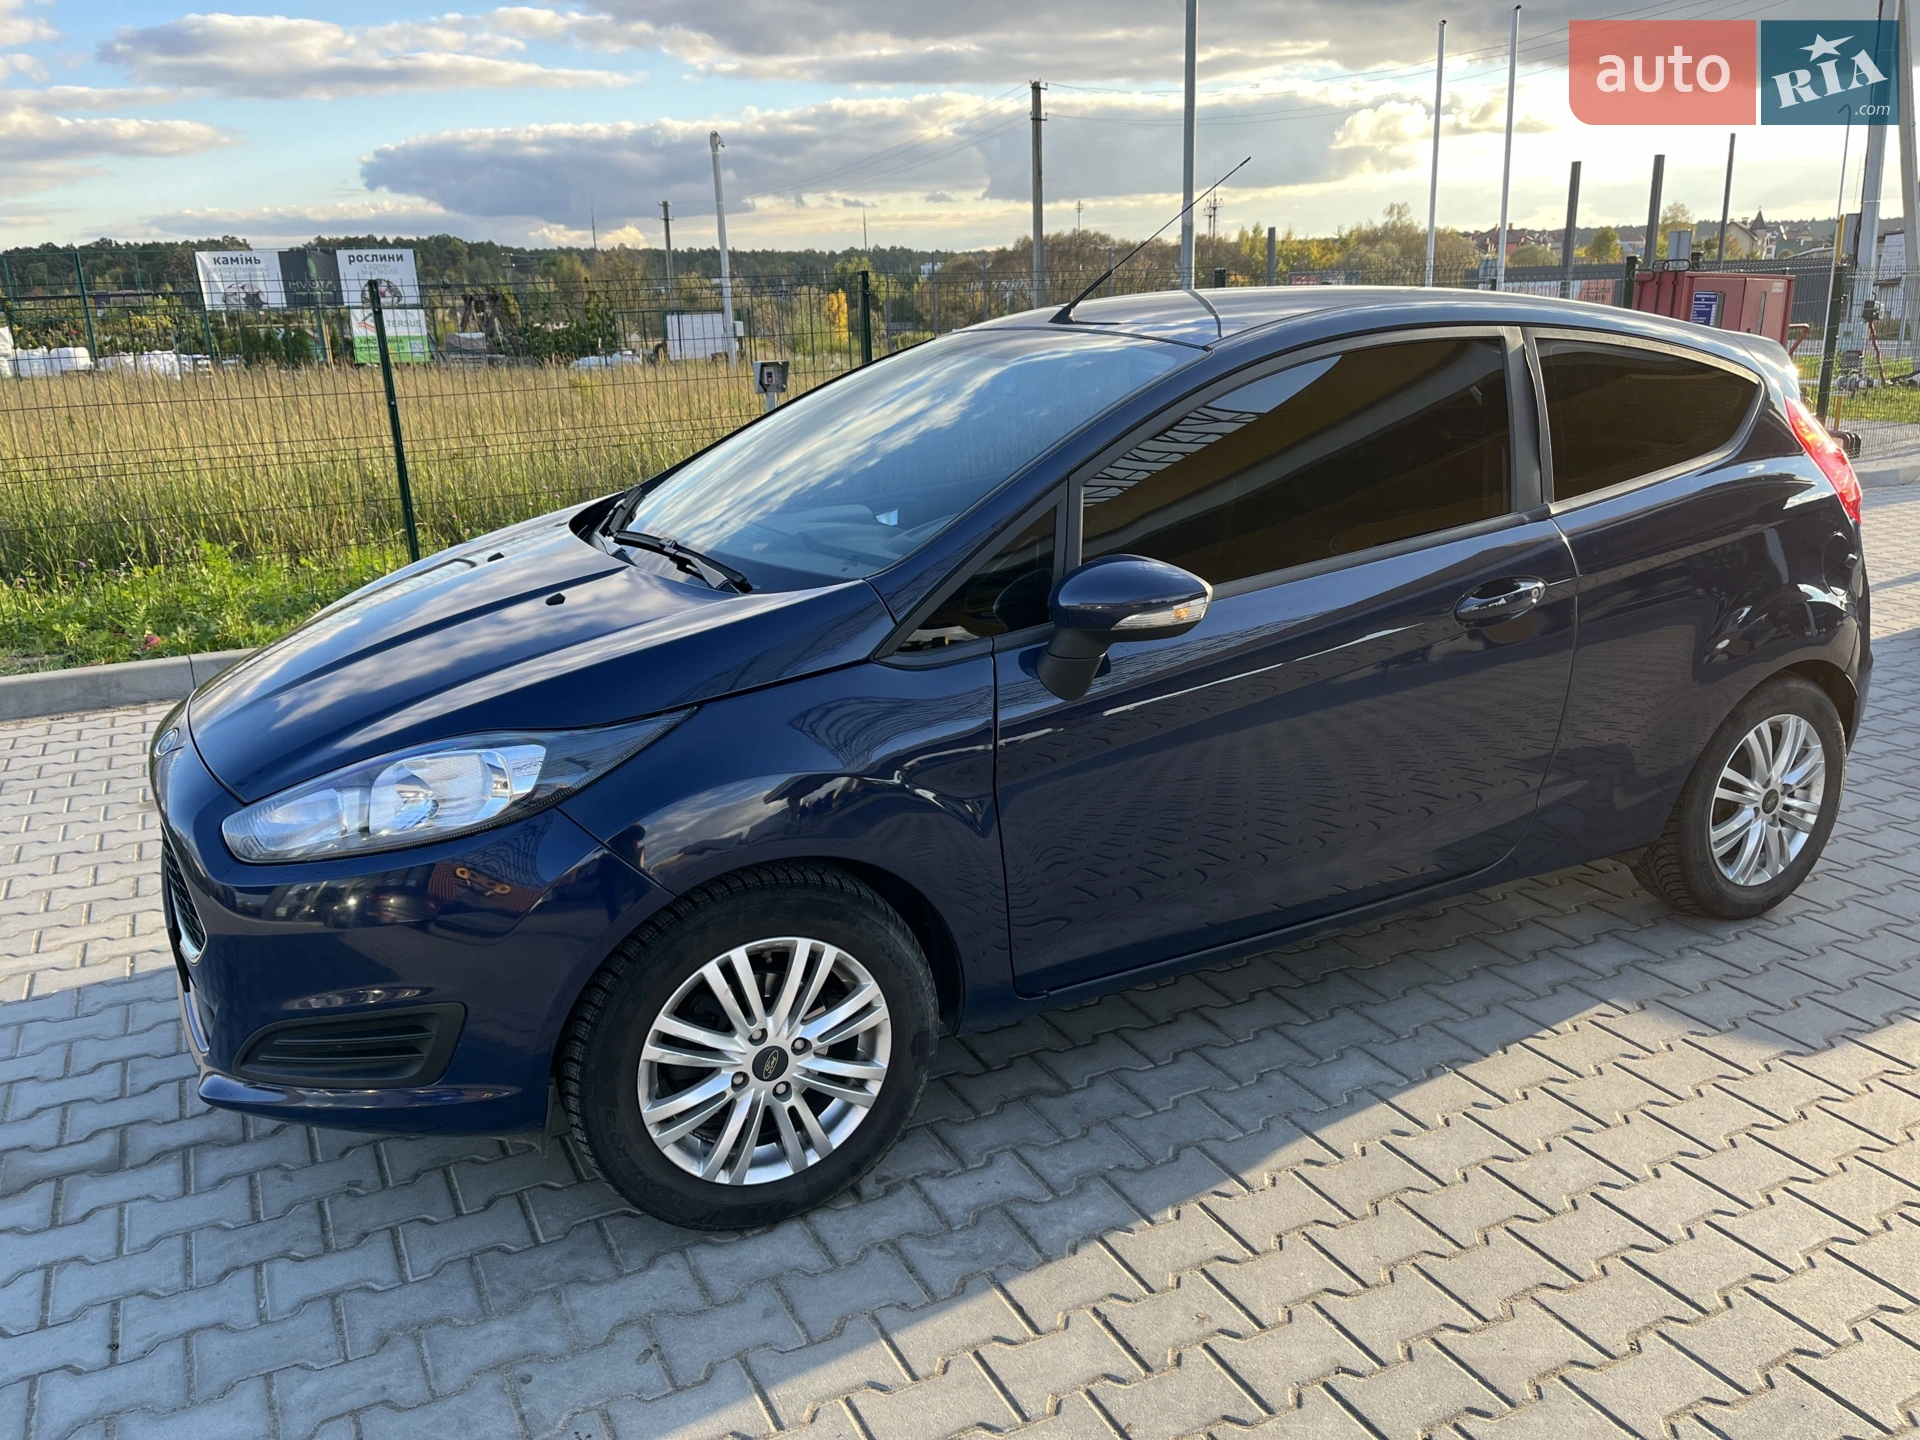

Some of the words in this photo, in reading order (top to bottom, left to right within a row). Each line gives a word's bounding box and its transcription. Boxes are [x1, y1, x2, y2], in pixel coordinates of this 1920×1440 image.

[213, 254, 261, 265] камінь
[348, 254, 404, 265] рослини
[387, 319, 422, 328] TERSUS
